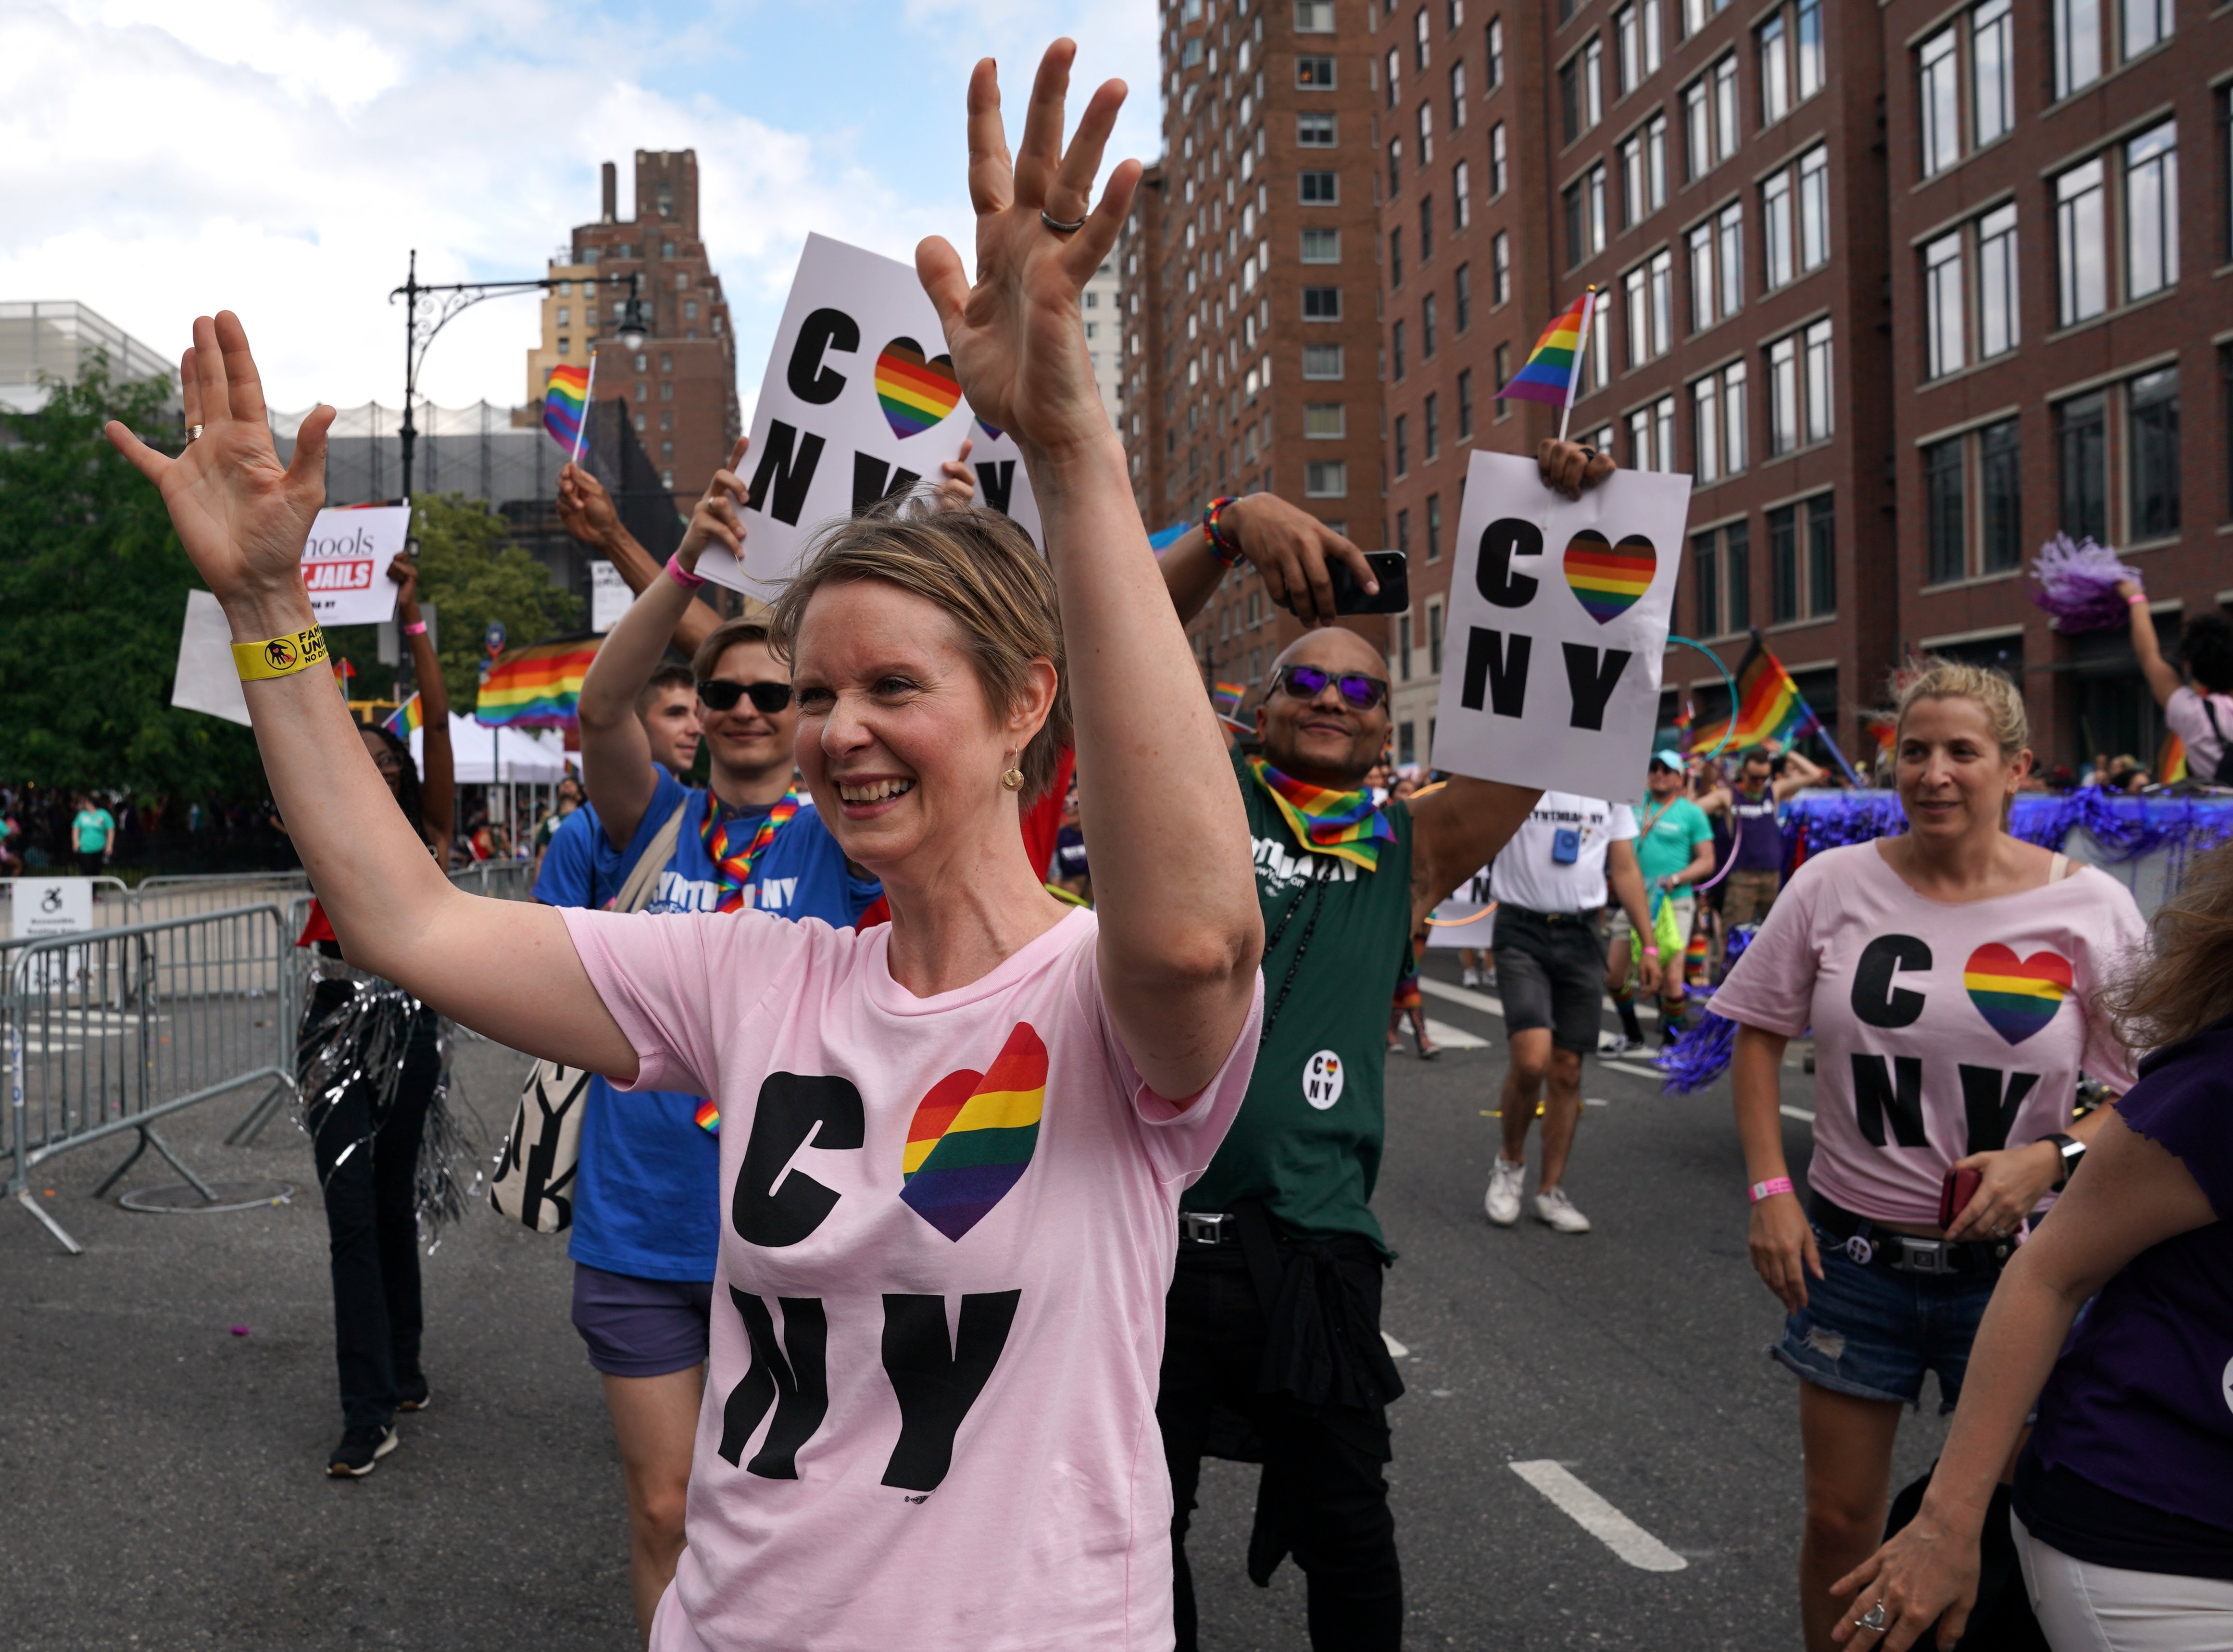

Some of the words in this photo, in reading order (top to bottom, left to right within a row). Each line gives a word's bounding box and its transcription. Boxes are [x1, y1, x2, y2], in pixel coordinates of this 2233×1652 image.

[787, 308, 860, 405] C
[307, 563, 370, 589] JAILS
[1476, 517, 1543, 608] C
[304, 653, 316, 663] NO
[761, 876, 799, 909] NY
[1851, 934, 1933, 1028] C
[1314, 1056, 1323, 1075] C
[732, 1071, 865, 1247] C
